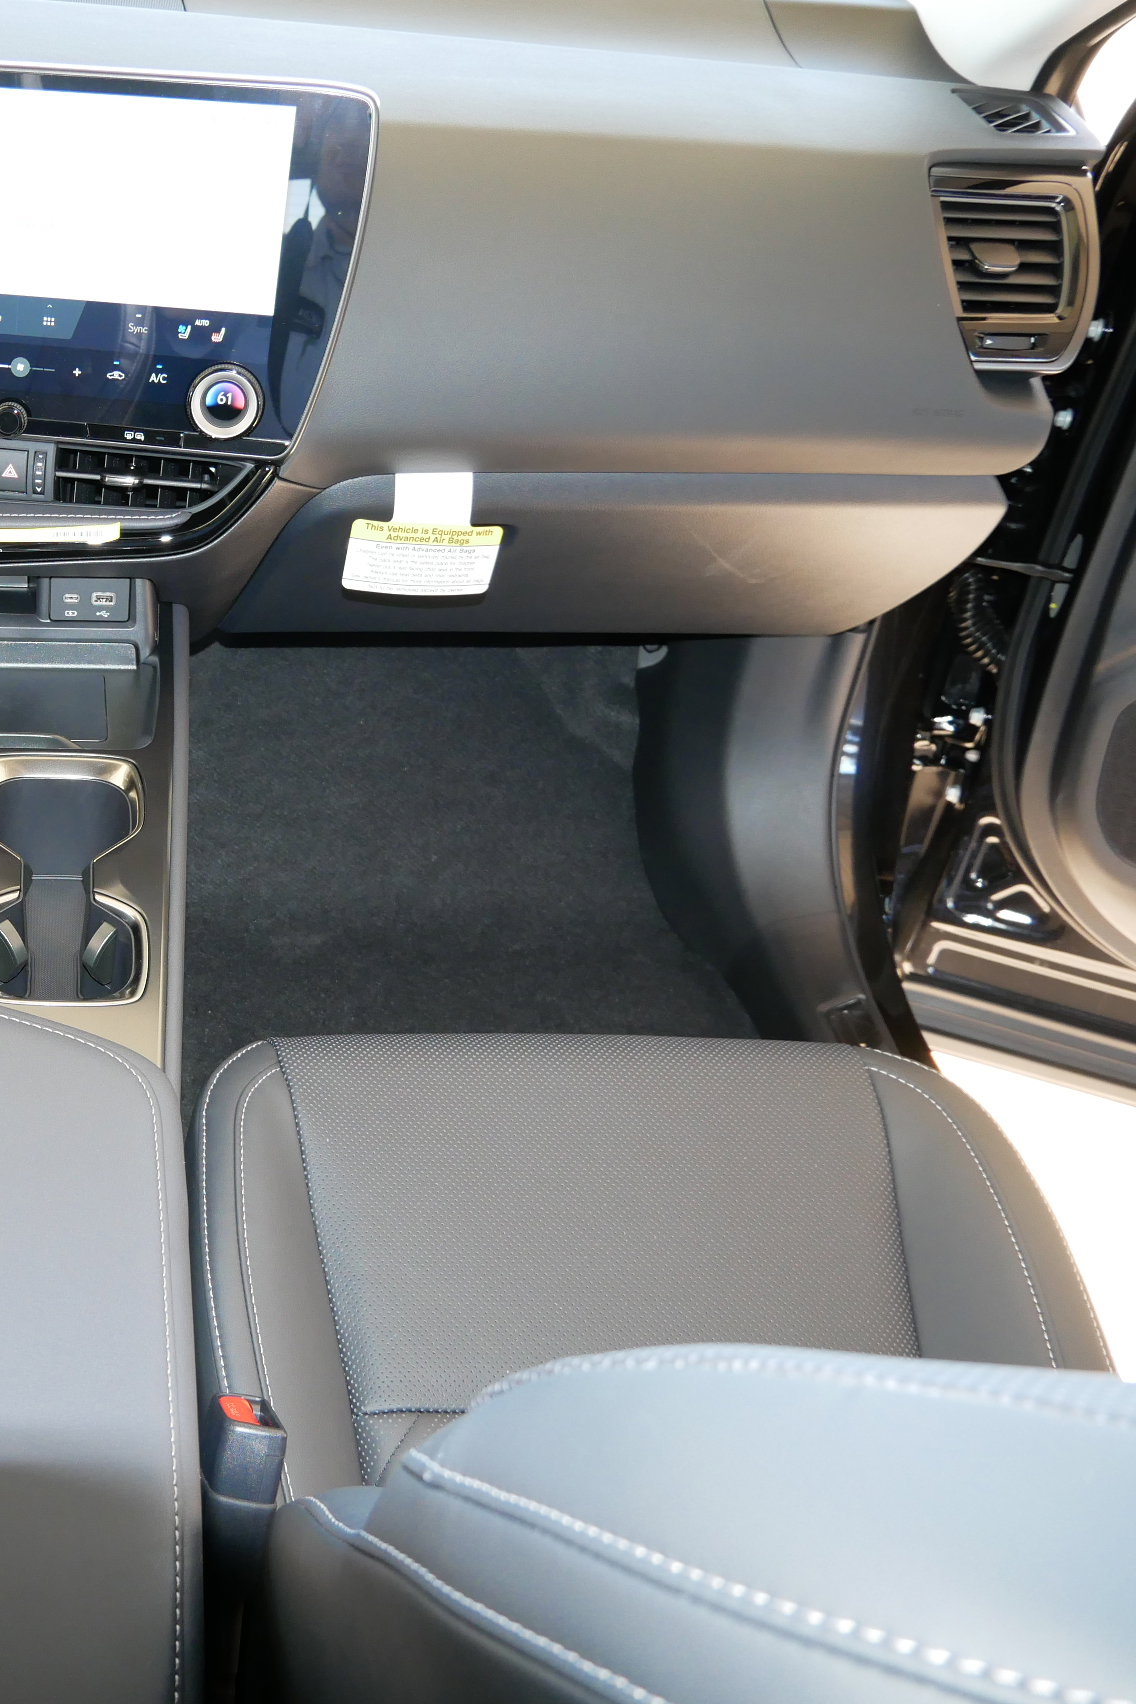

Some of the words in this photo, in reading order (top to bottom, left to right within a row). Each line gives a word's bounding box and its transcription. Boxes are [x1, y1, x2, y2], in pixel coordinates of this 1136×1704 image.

[128, 323, 149, 335] Sync
[194, 318, 210, 327] AUTO
[149, 373, 168, 384] A/C
[217, 391, 233, 405] 61
[365, 522, 385, 532] This
[387, 525, 419, 534] Vehicle
[431, 527, 474, 538] Equipped
[475, 528, 494, 537] with
[386, 533, 431, 543] Advanced
[432, 536, 446, 544] Air
[447, 537, 470, 547] Bags
